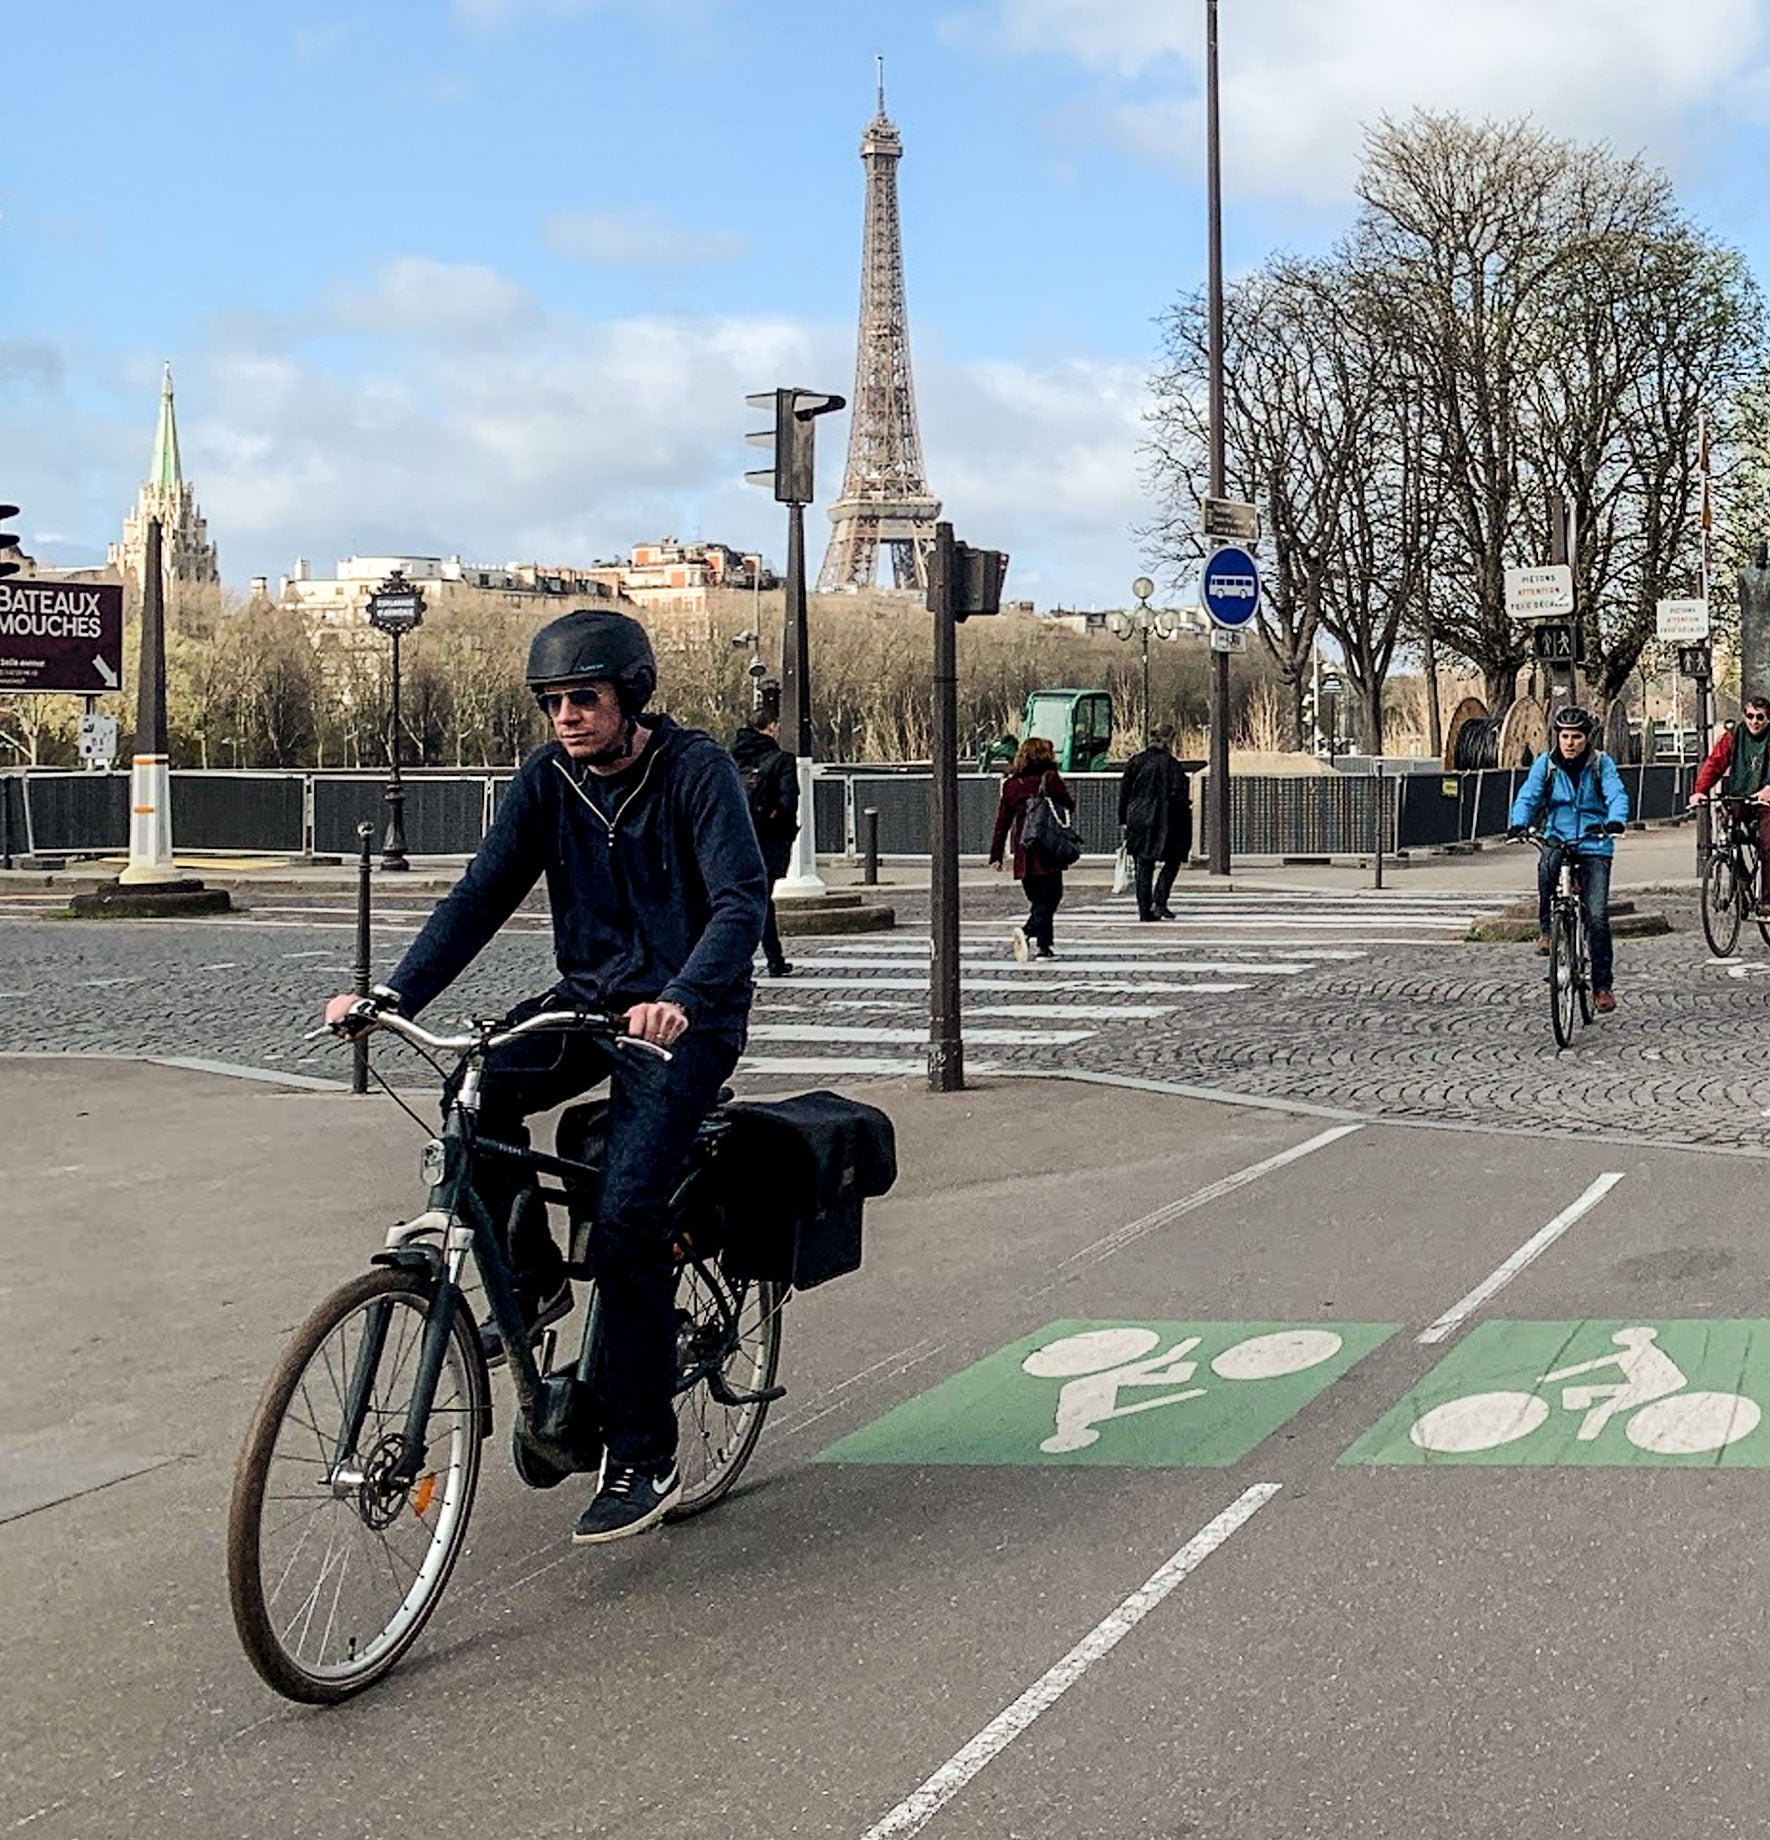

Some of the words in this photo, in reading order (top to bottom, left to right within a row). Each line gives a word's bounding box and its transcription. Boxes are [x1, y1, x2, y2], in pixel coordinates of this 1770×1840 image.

[0, 585, 101, 616] BATEAUX
[1517, 586, 1560, 596] ATTENTION
[0, 613, 101, 638] MOUCHES
